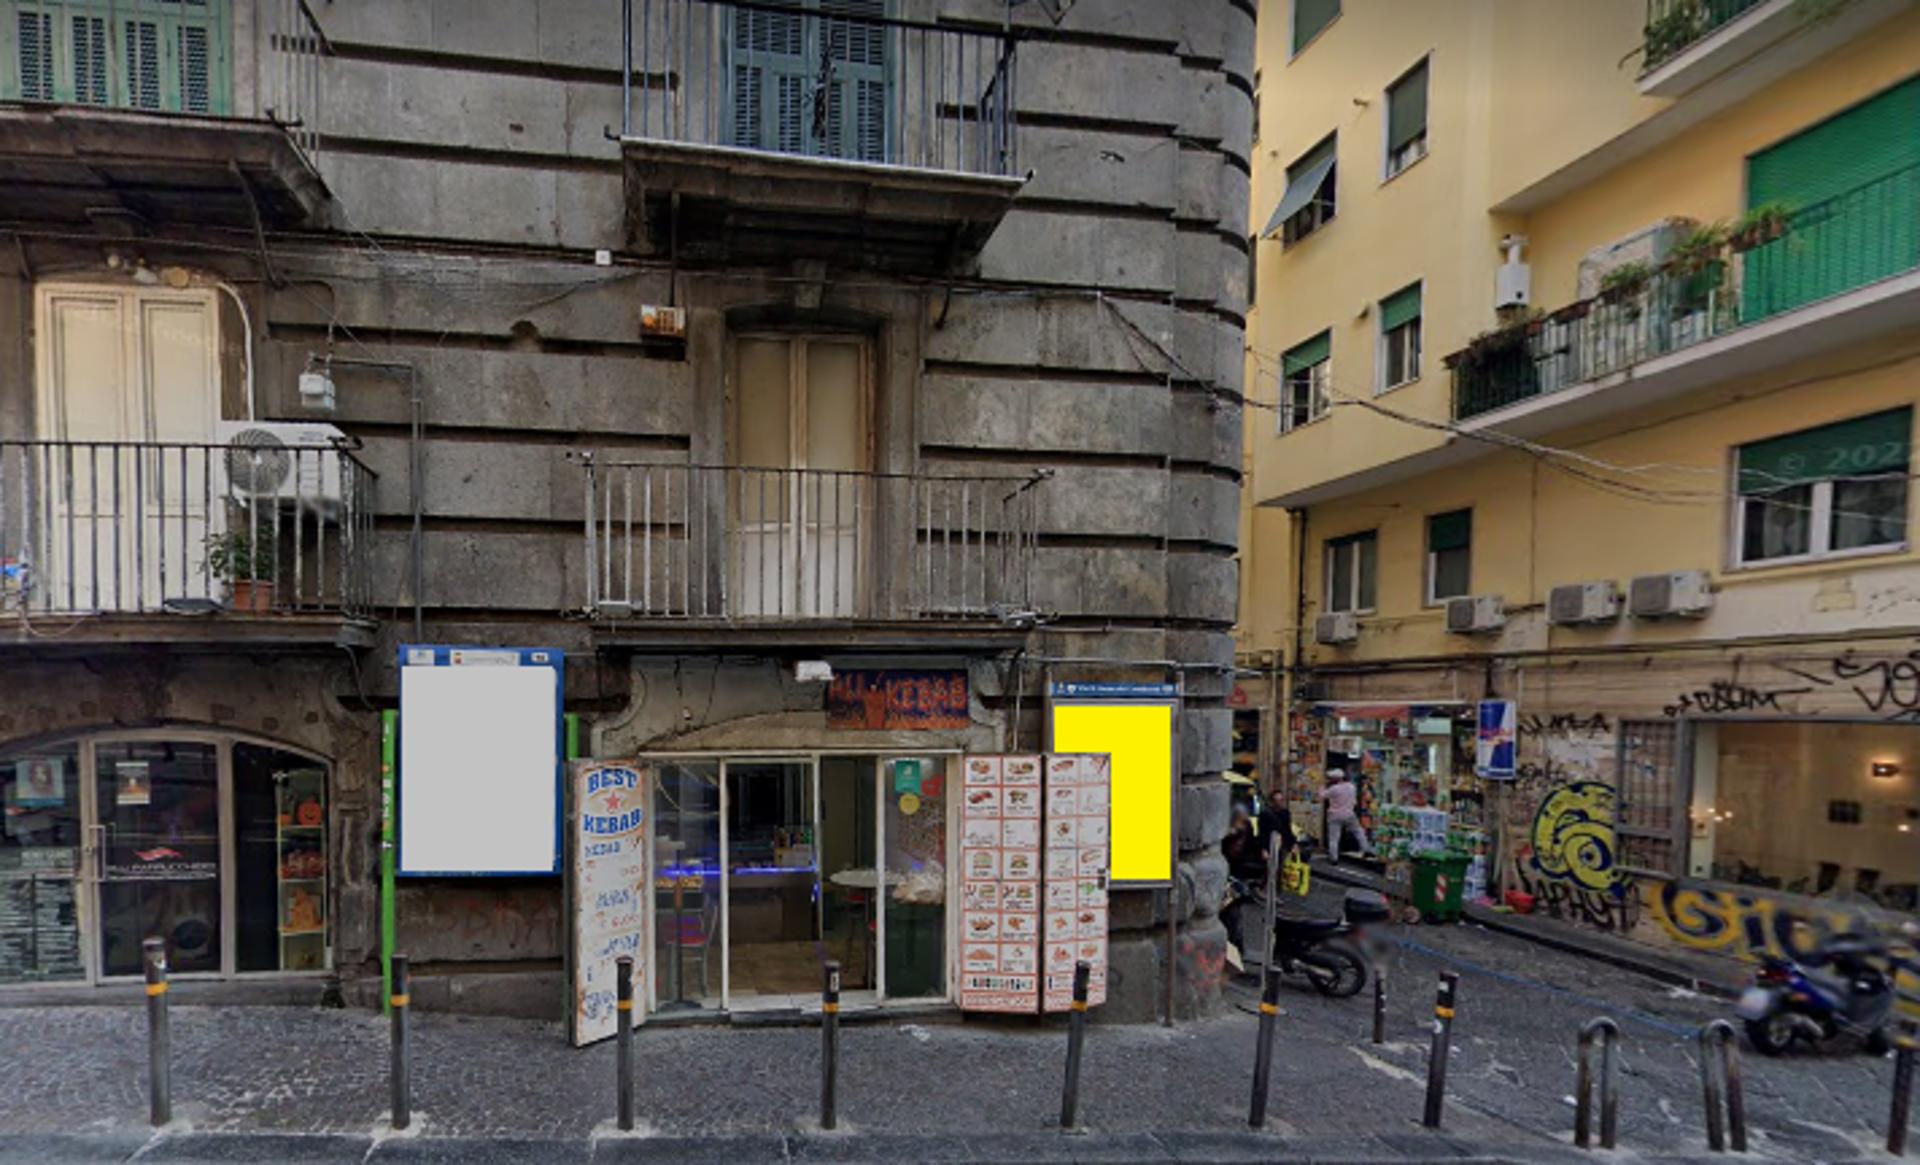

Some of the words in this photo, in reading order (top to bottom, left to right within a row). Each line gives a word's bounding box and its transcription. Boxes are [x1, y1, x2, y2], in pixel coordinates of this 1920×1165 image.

[886, 675, 967, 711] KEBAB
[587, 767, 638, 794] BEST
[583, 808, 642, 834] KEBAB
